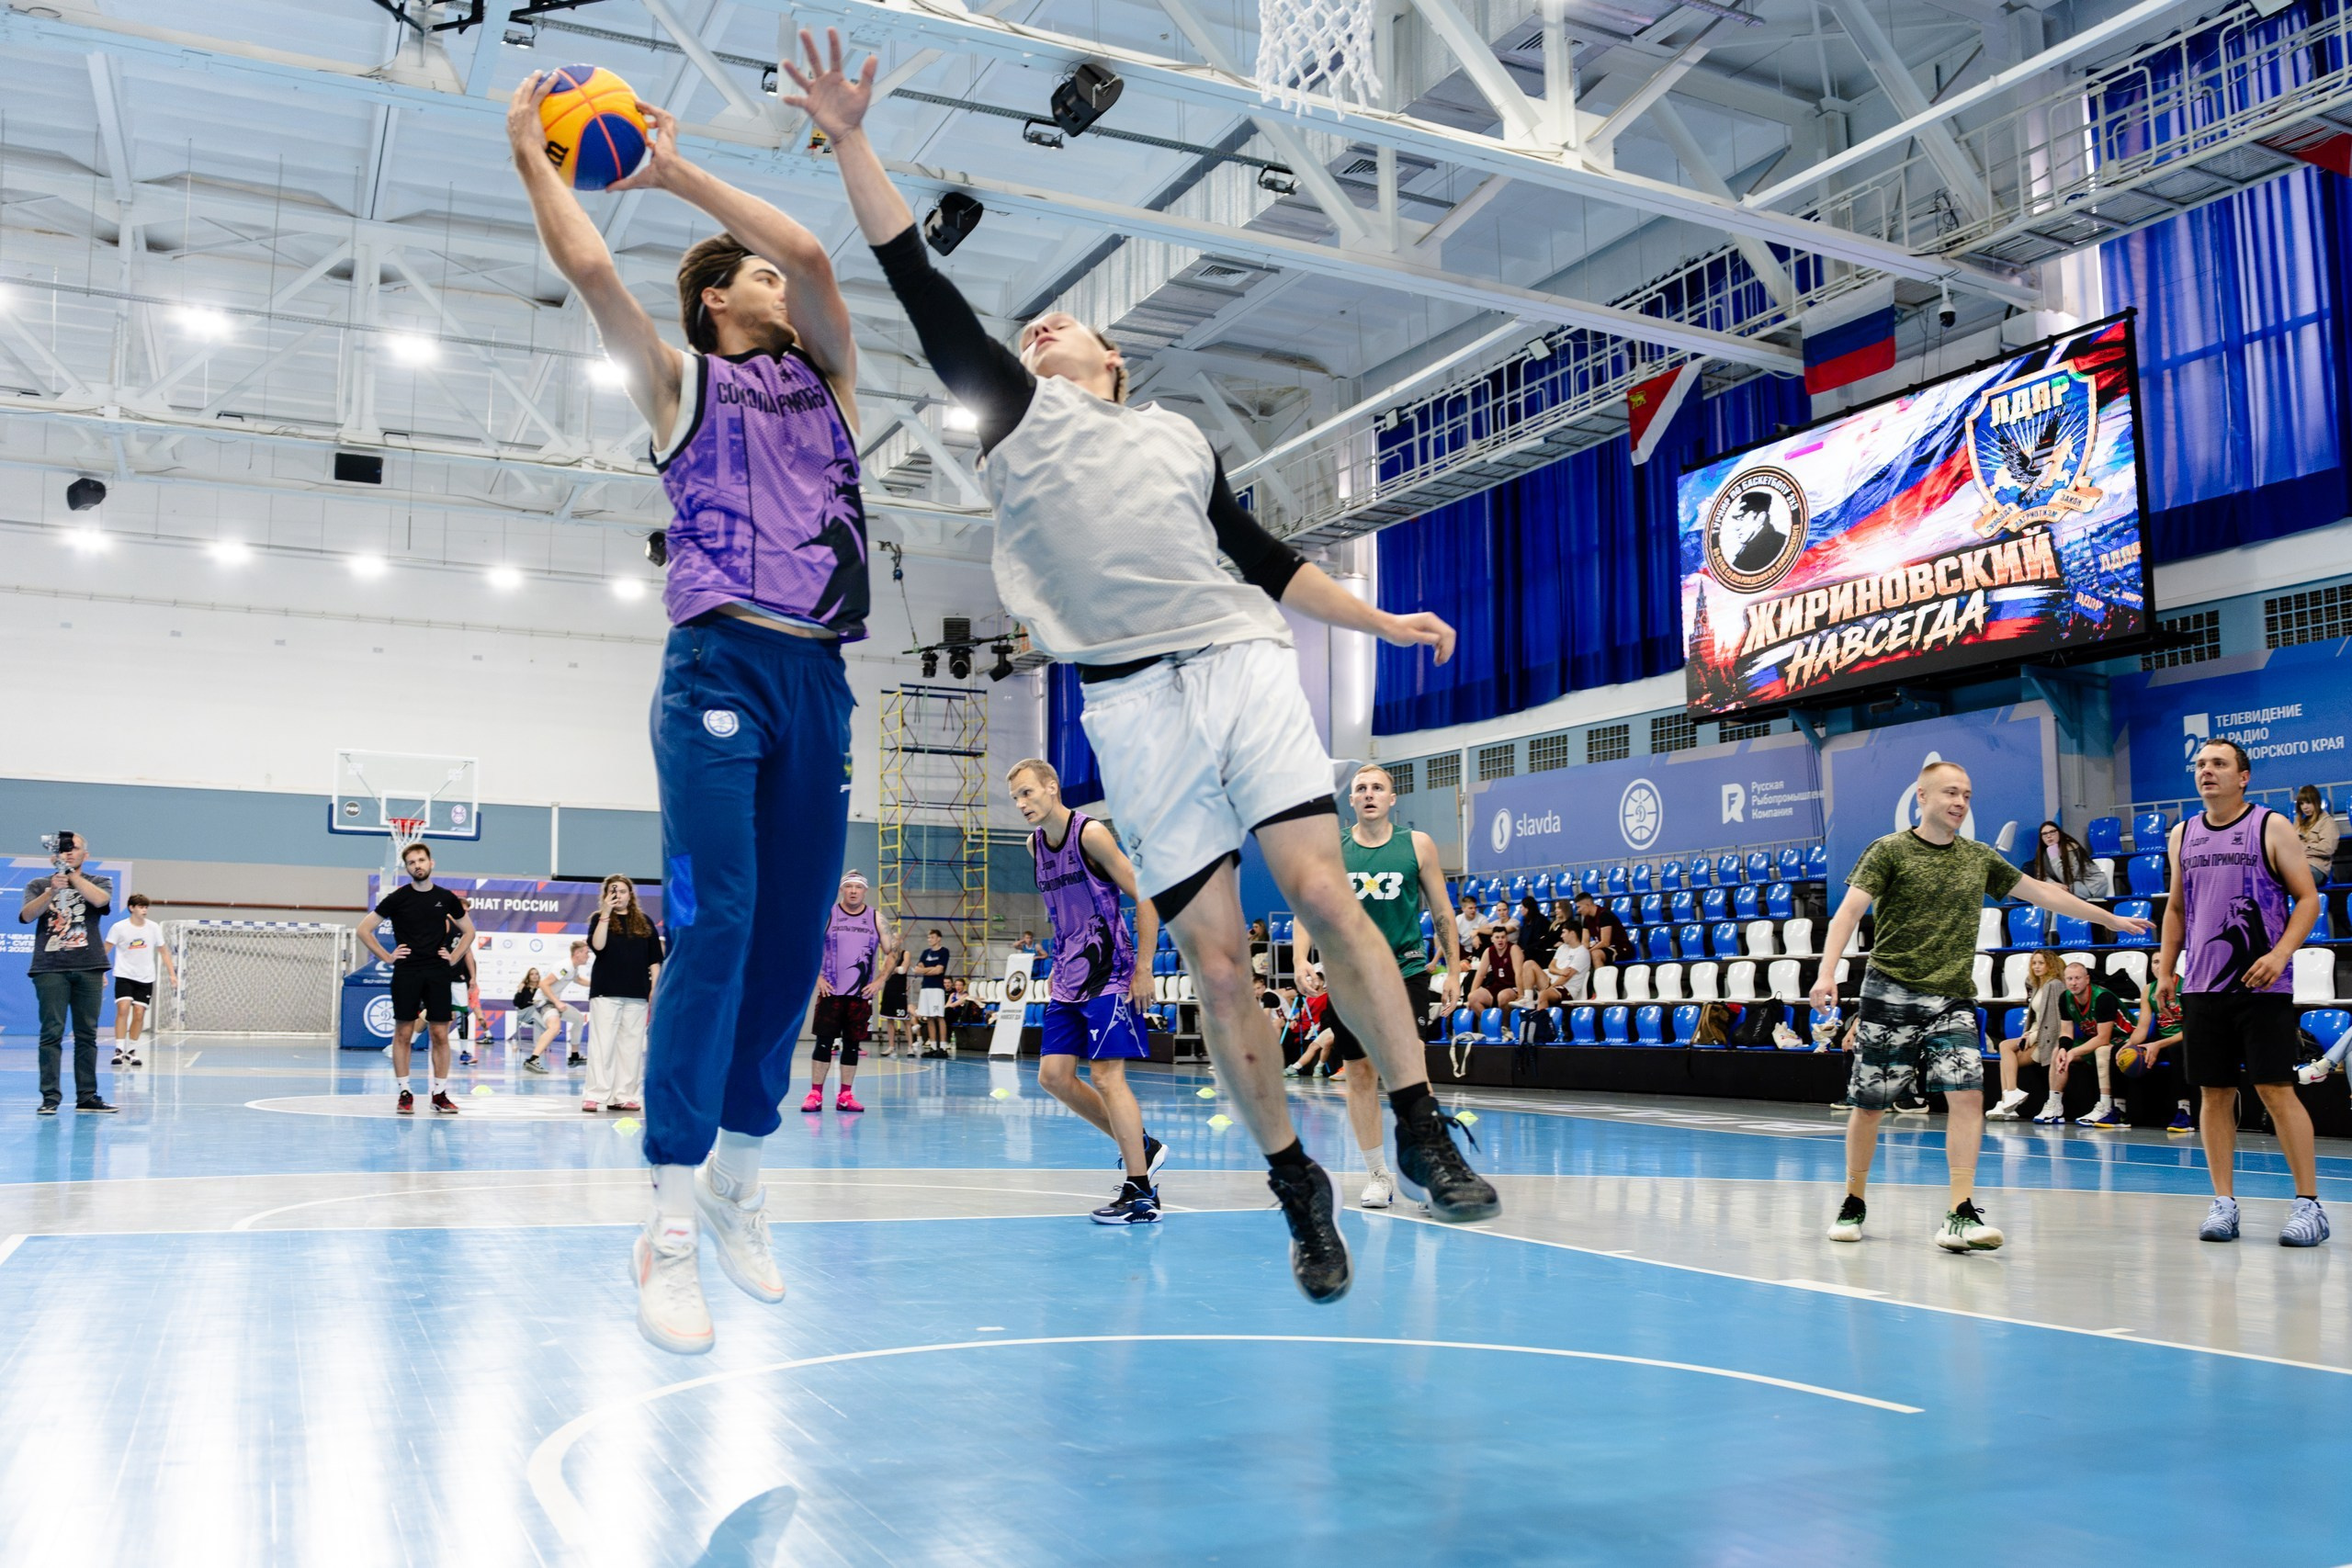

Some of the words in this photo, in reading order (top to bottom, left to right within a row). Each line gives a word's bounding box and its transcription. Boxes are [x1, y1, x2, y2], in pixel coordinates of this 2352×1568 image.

[1990, 375, 2070, 427] ЛДПР
[1712, 496, 1732, 533] ТУРНИР
[1729, 486, 1743, 500] ПО
[1742, 475, 1792, 495] БАСКЕТБОЛУ
[2060, 494, 2083, 507] ЗАКОН
[1739, 526, 2061, 659] ЖИРИНОВСКИЙ
[1785, 590, 1990, 692] НАВСЕГДА
[2215, 704, 2303, 728] ТЕЛЕВИДЕНИЕ
[2227, 728, 2269, 745] РАДИО
[2311, 736, 2345, 752] КРАЯ
[1751, 781, 1785, 794] Русская
[1751, 807, 1793, 819] Компания
[1516, 809, 1561, 837] slavda
[2211, 852, 2258, 868] ПРИМОРЬЯ
[503, 898, 560, 912] РОССИИ
